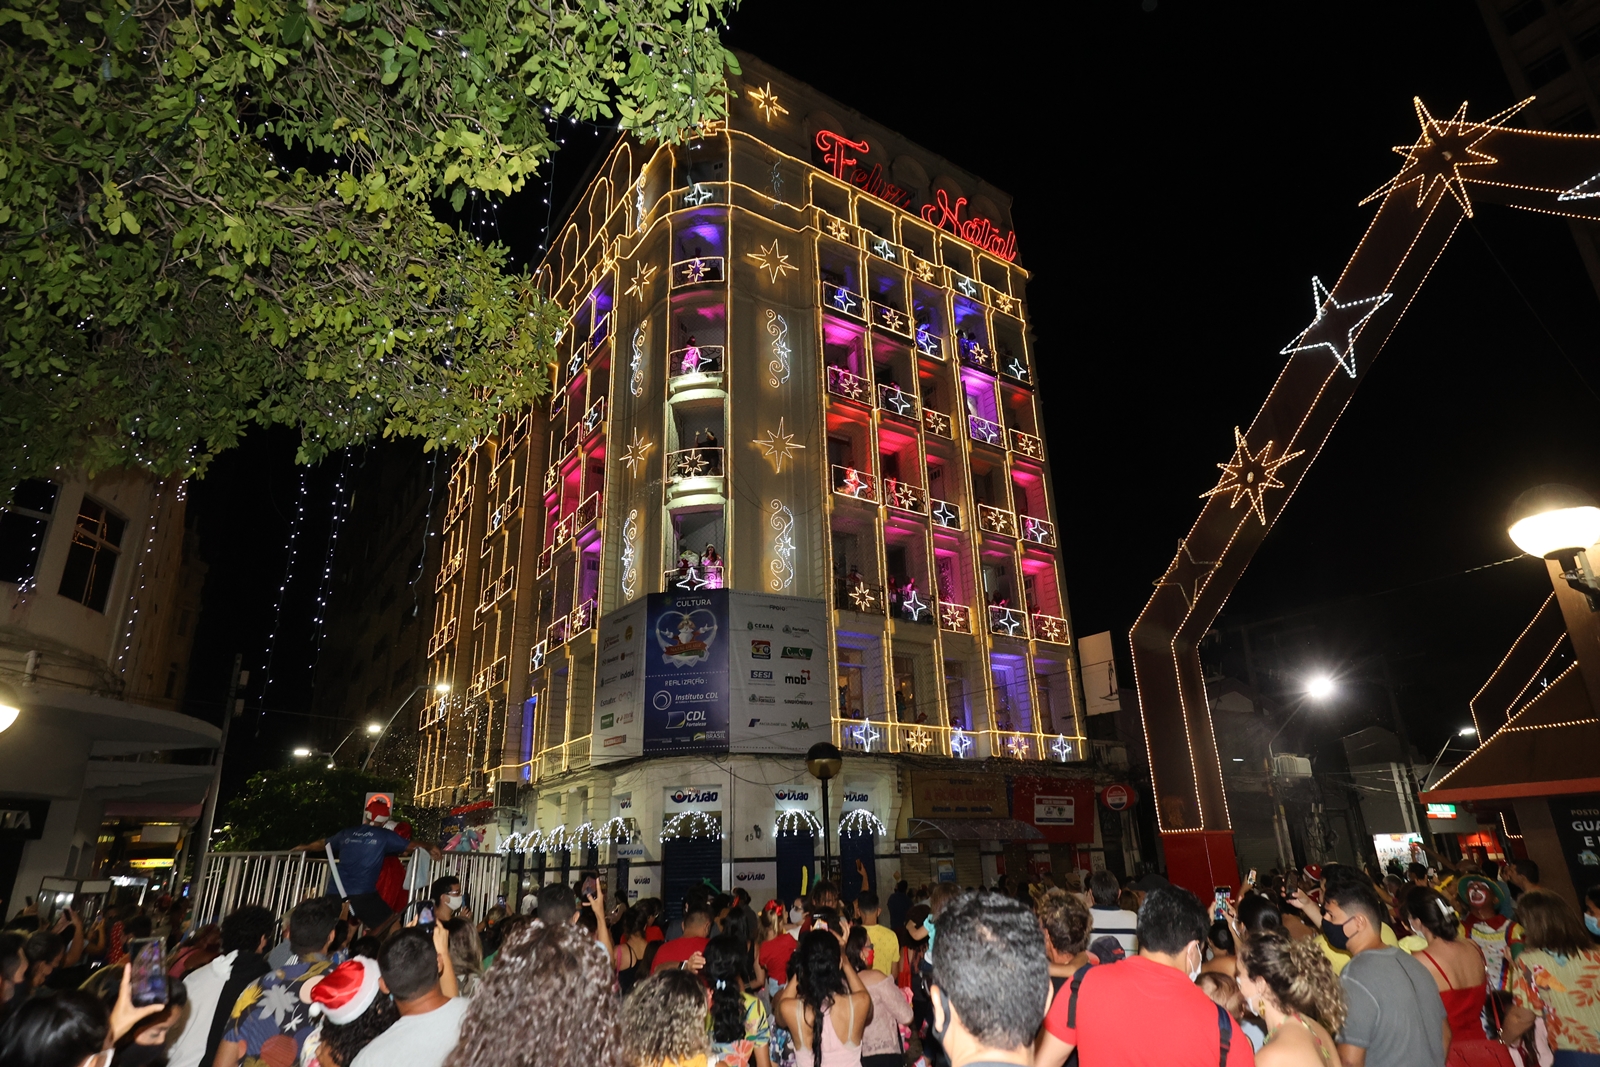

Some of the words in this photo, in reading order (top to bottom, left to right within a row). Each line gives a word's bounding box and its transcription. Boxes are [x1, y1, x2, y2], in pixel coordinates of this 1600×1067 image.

[675, 598, 712, 608] CULTURA
[752, 671, 771, 679] SESI
[784, 674, 807, 685] mob
[674, 692, 704, 702] Instituto
[704, 691, 719, 700] CDL
[686, 710, 707, 722] CDL
[1583, 836, 1595, 847] E
